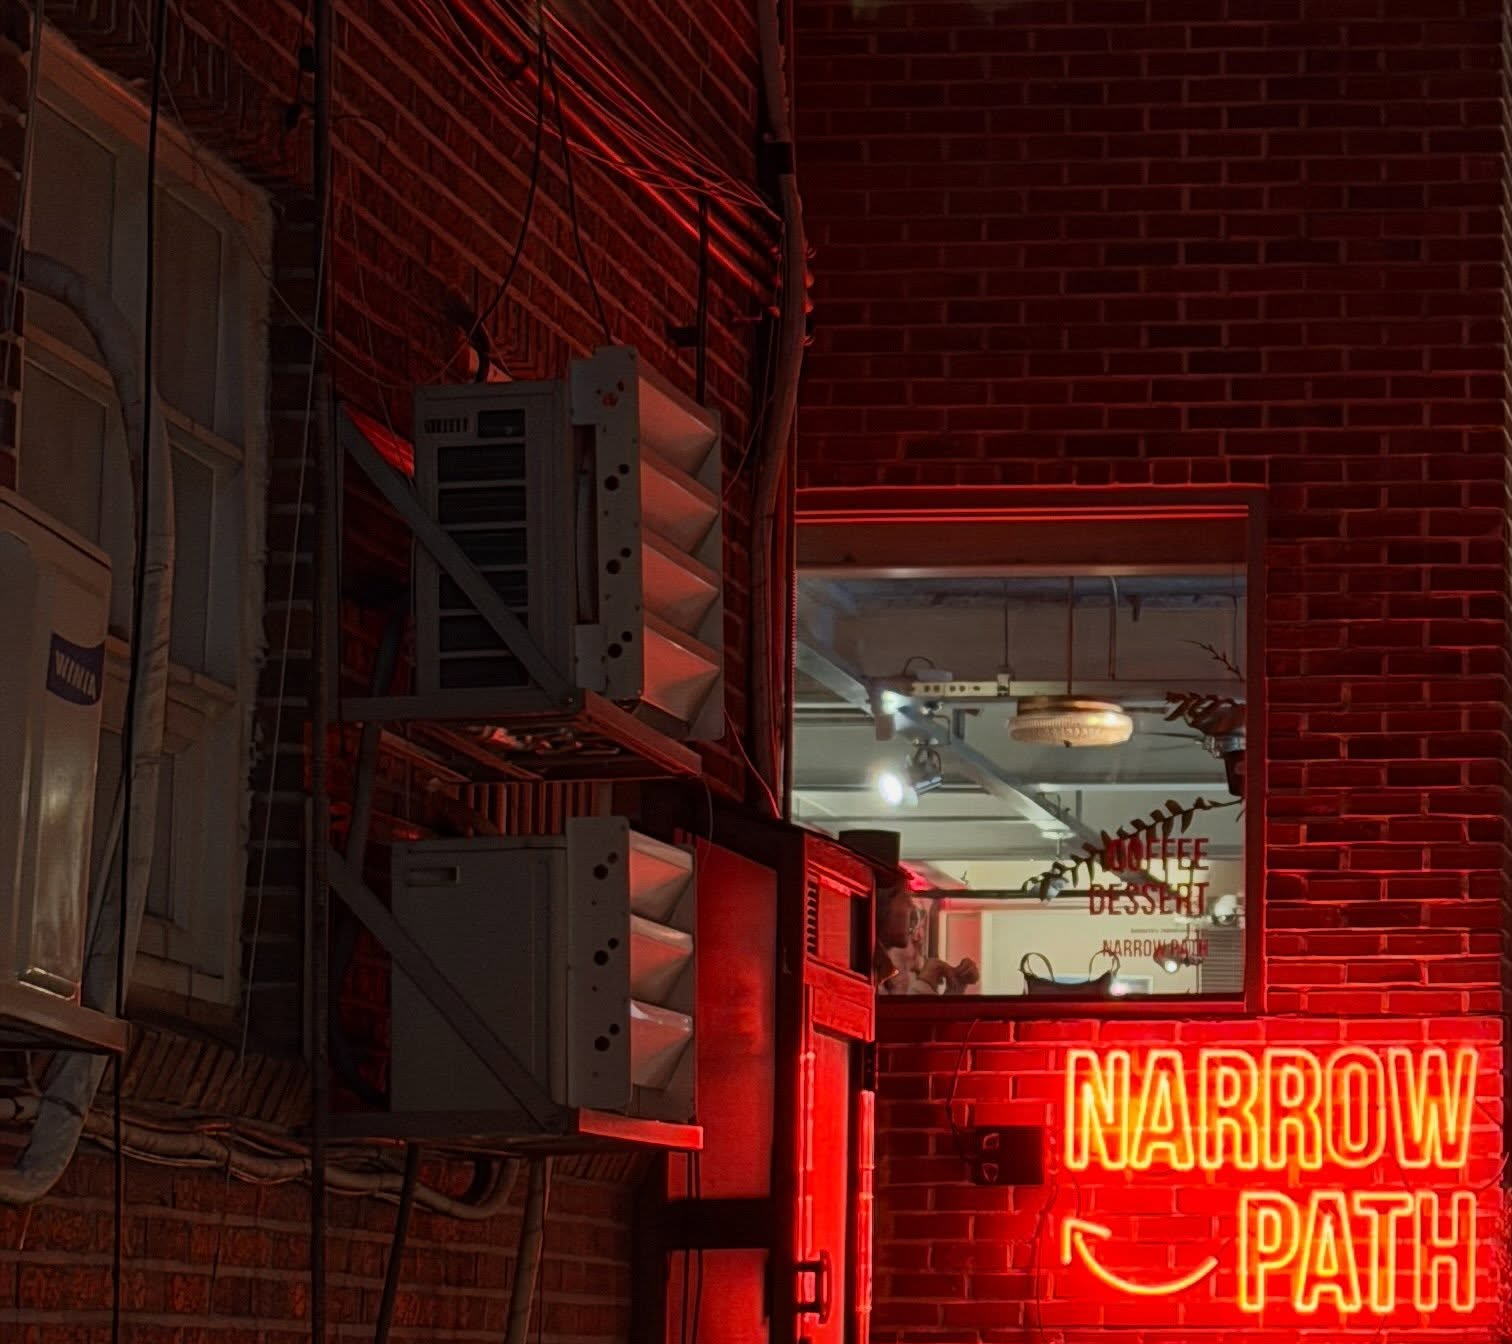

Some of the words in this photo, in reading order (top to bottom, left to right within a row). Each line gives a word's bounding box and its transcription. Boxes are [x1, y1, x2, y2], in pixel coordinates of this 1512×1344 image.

[55, 649, 97, 701] WINIA
[1106, 838, 1209, 871] COFFEE
[1089, 882, 1209, 916] DESSERT
[1102, 939, 1166, 957] NARROW
[1064, 1044, 1479, 1171] NARROW
[1239, 1189, 1478, 1314] PATH
